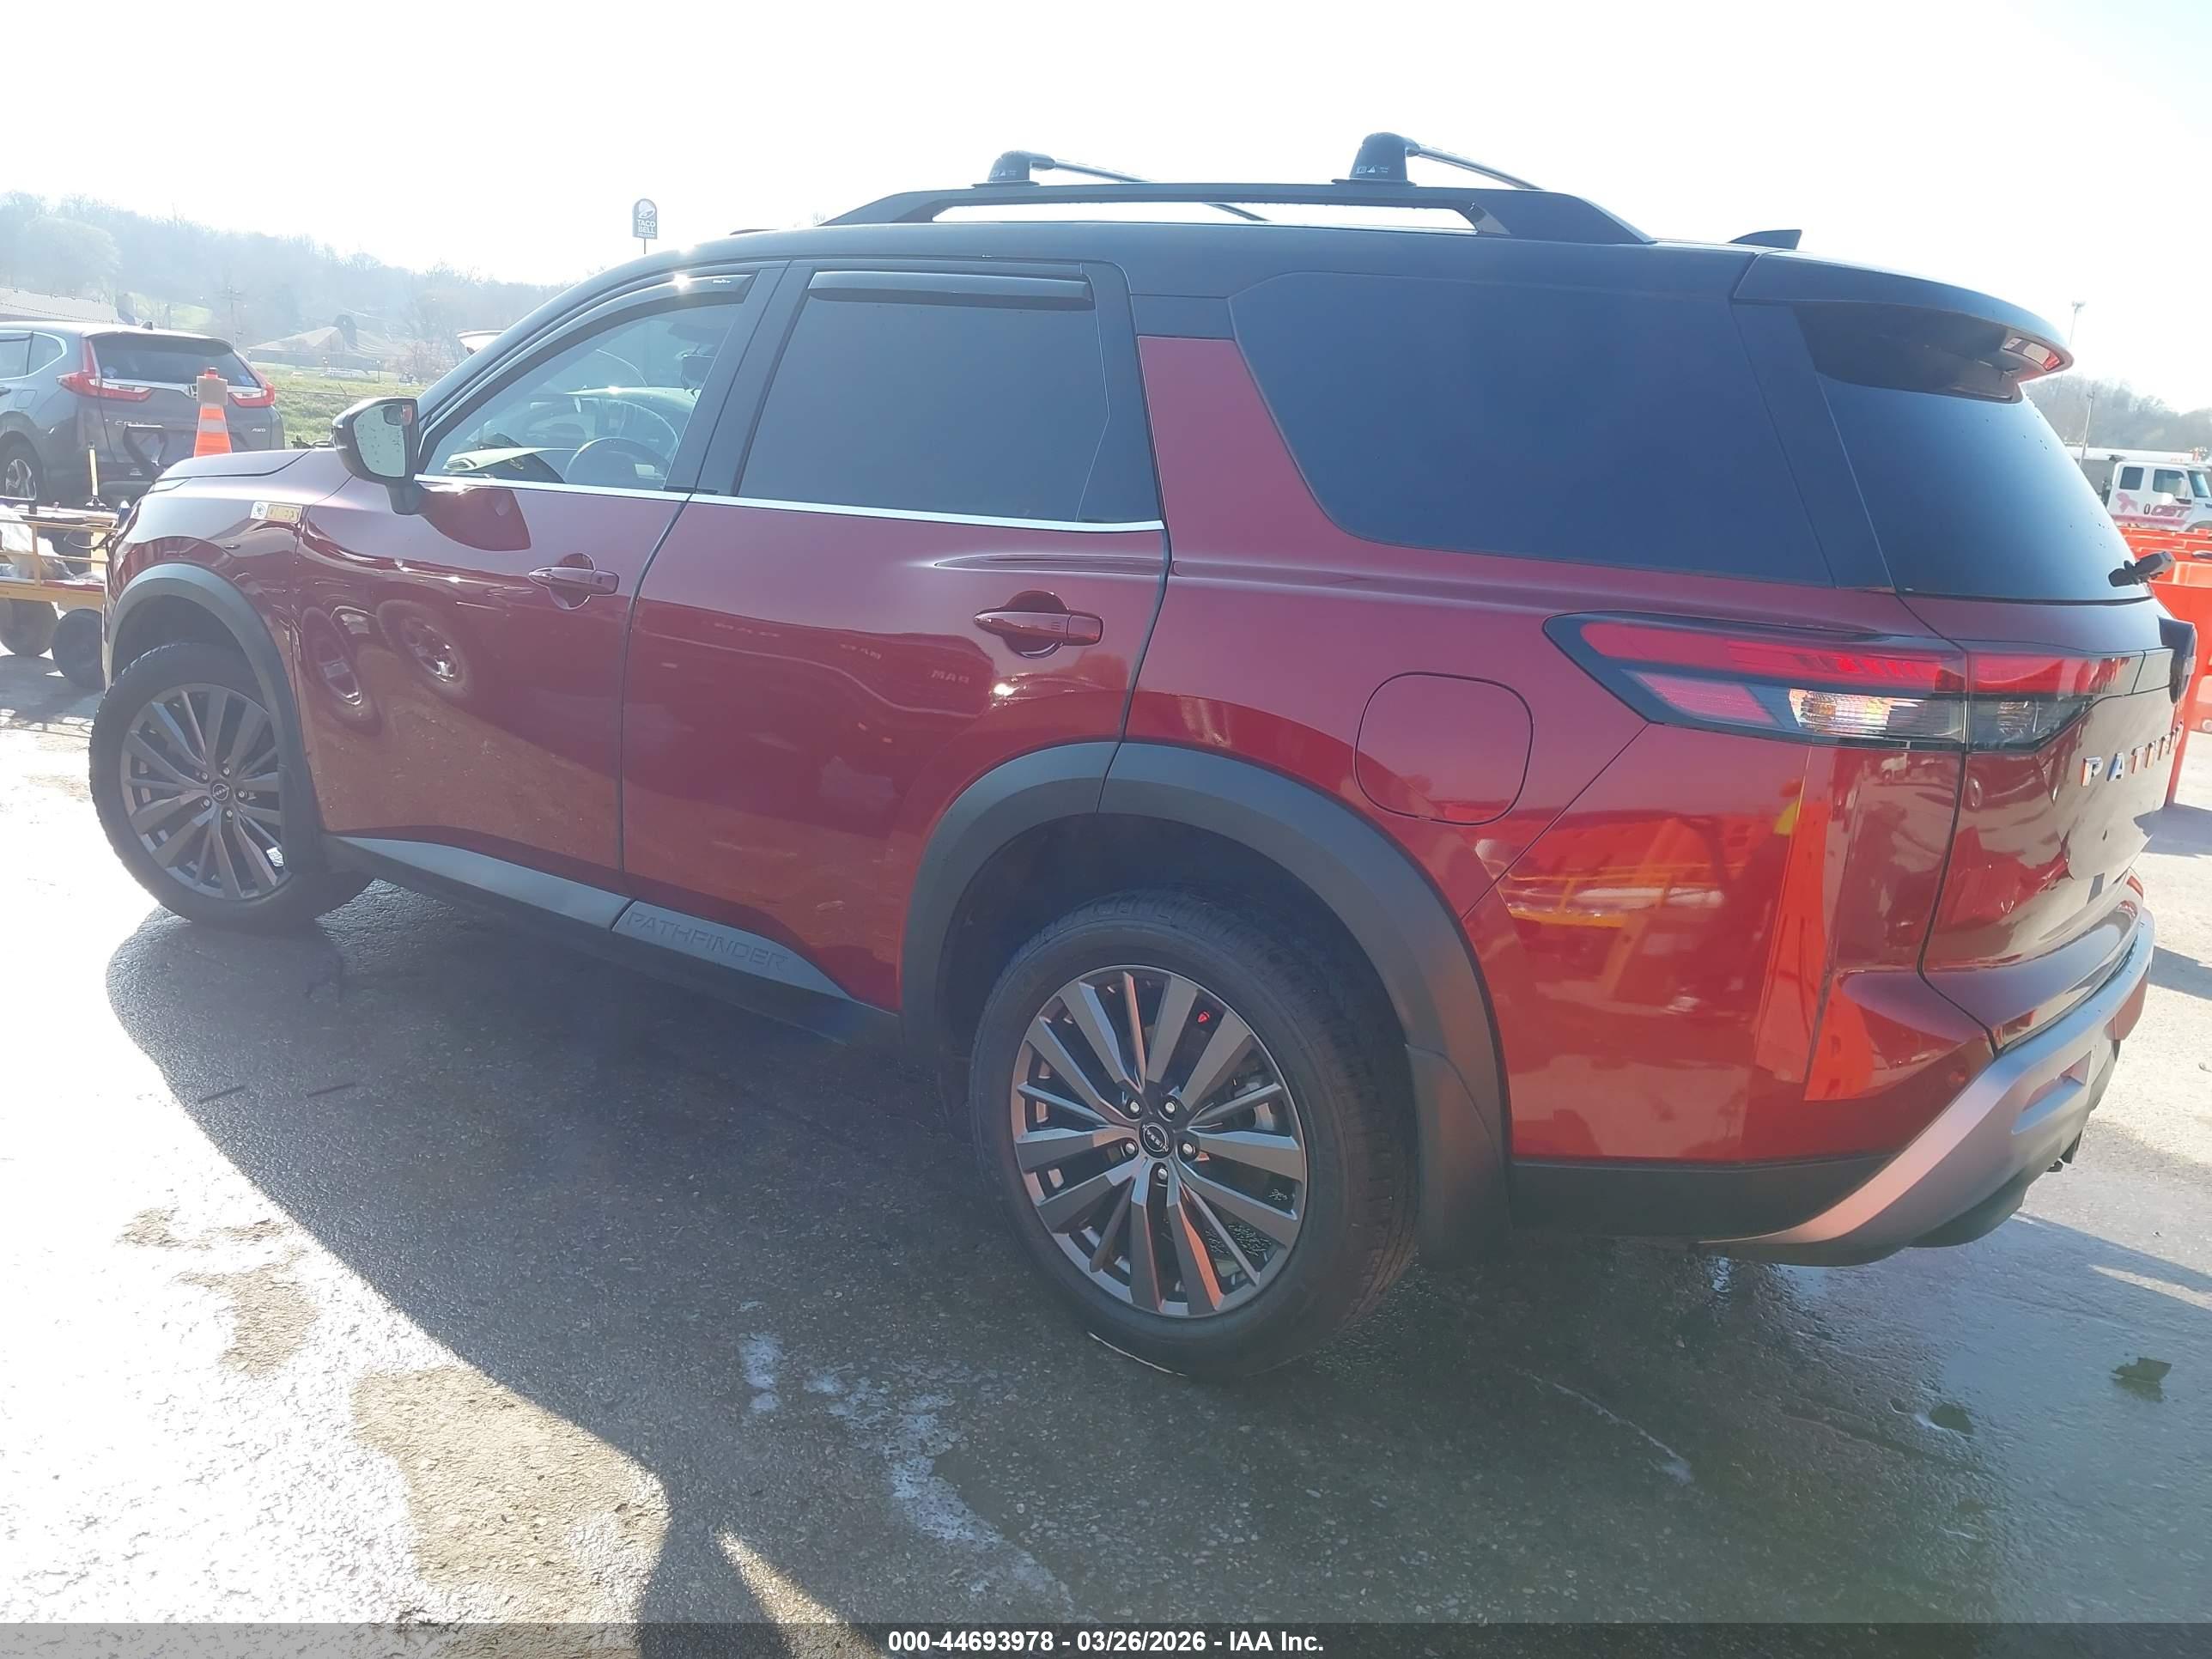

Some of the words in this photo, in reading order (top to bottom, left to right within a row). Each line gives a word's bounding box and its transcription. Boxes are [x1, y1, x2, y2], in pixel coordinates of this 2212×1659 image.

[638, 219, 656, 228] TACO
[638, 226, 656, 234] BELL
[626, 912, 789, 971] PATHFINDER
